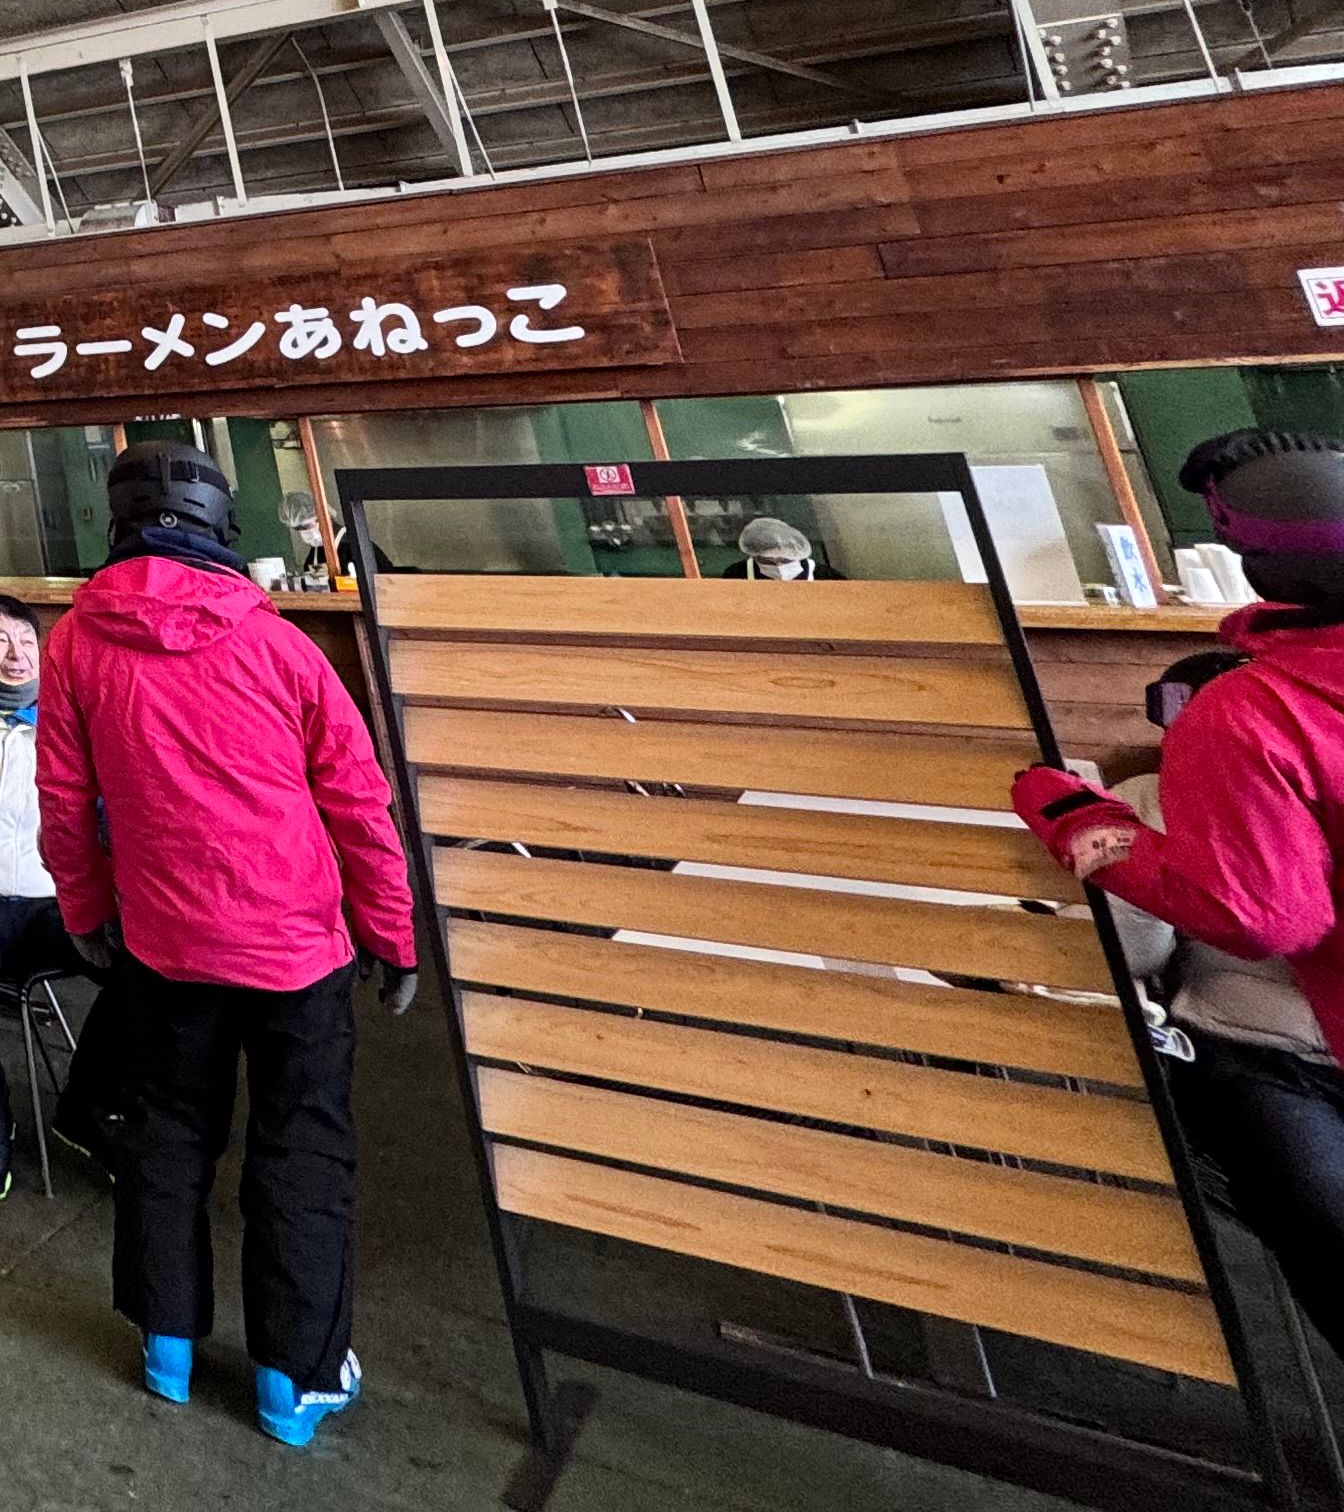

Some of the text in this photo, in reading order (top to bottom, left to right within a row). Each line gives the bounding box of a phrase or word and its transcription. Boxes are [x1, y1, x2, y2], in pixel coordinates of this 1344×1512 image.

[13, 283, 585, 378] ラーメンあねっこ
